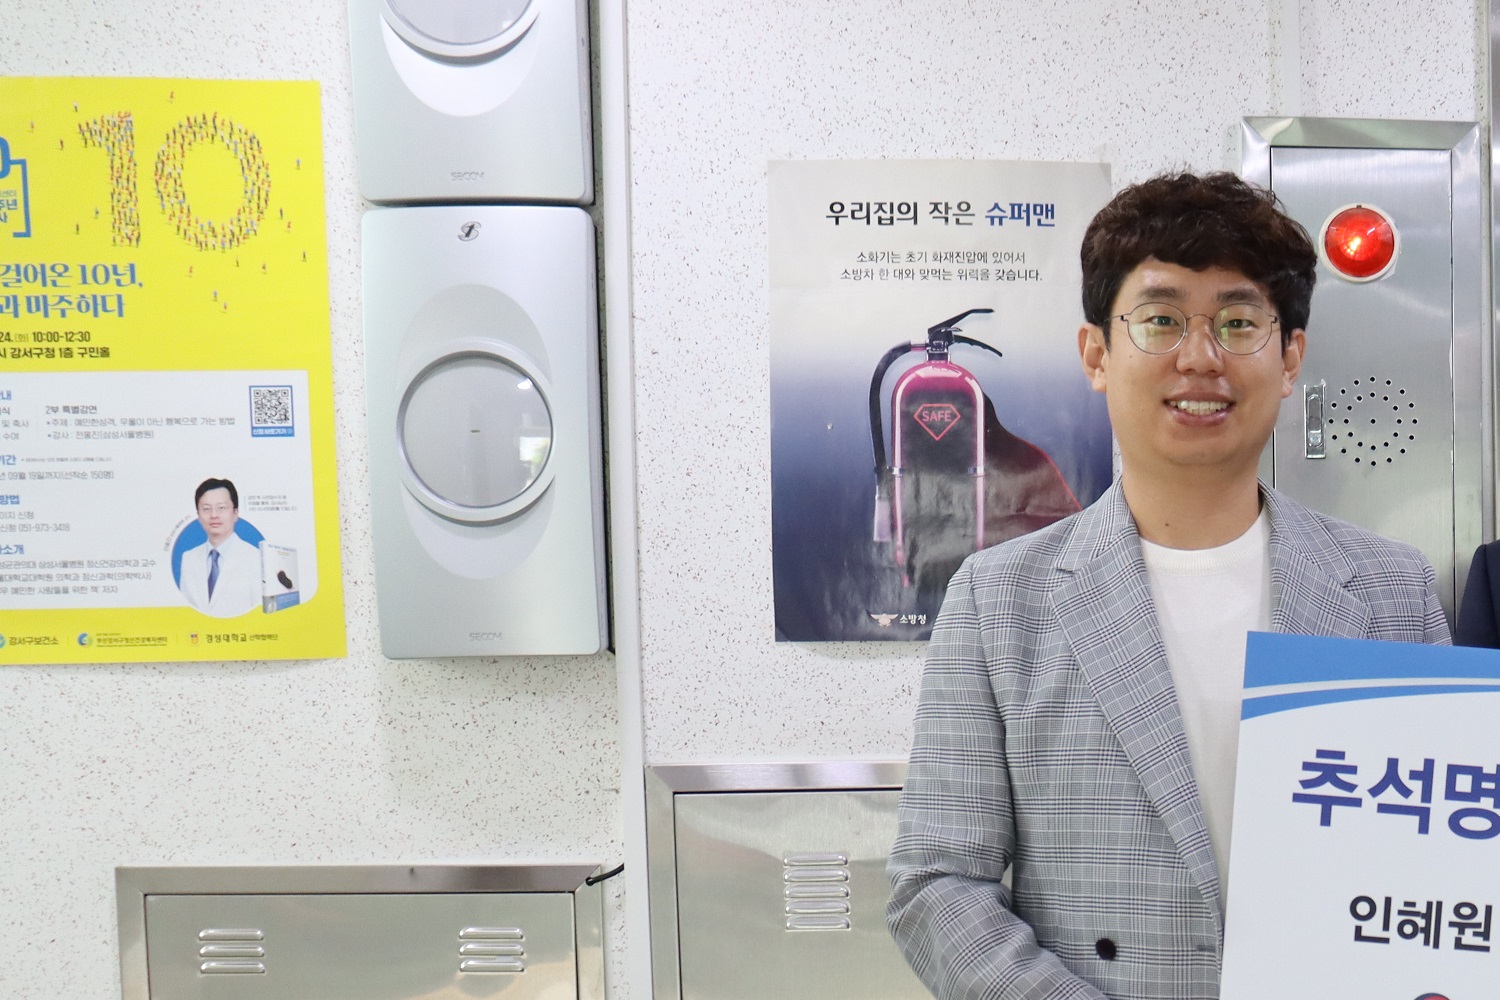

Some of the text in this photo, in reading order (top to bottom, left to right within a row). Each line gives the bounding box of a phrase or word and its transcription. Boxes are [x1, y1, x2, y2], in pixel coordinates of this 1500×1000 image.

[826, 200, 1056, 228] 우리집의 작은 슈퍼맨
[856, 251, 1026, 265] 소화기는 초기 화재진압에 있어서
[0, 263, 143, 289] 걸어온 10년,
[840, 268, 1043, 282] 소방차 한 대와 맞먹는 위력을 갖습니다.
[25, 294, 125, 318] 마주하다
[32, 331, 91, 343] 10:00-12:30
[10, 347, 56, 359] 강서구청
[0, 390, 12, 401] 내
[921, 410, 952, 424] SAFE
[0, 544, 24, 555] 소개
[899, 612, 927, 626] 소방청
[1348, 895, 1494, 953] 인혜원
